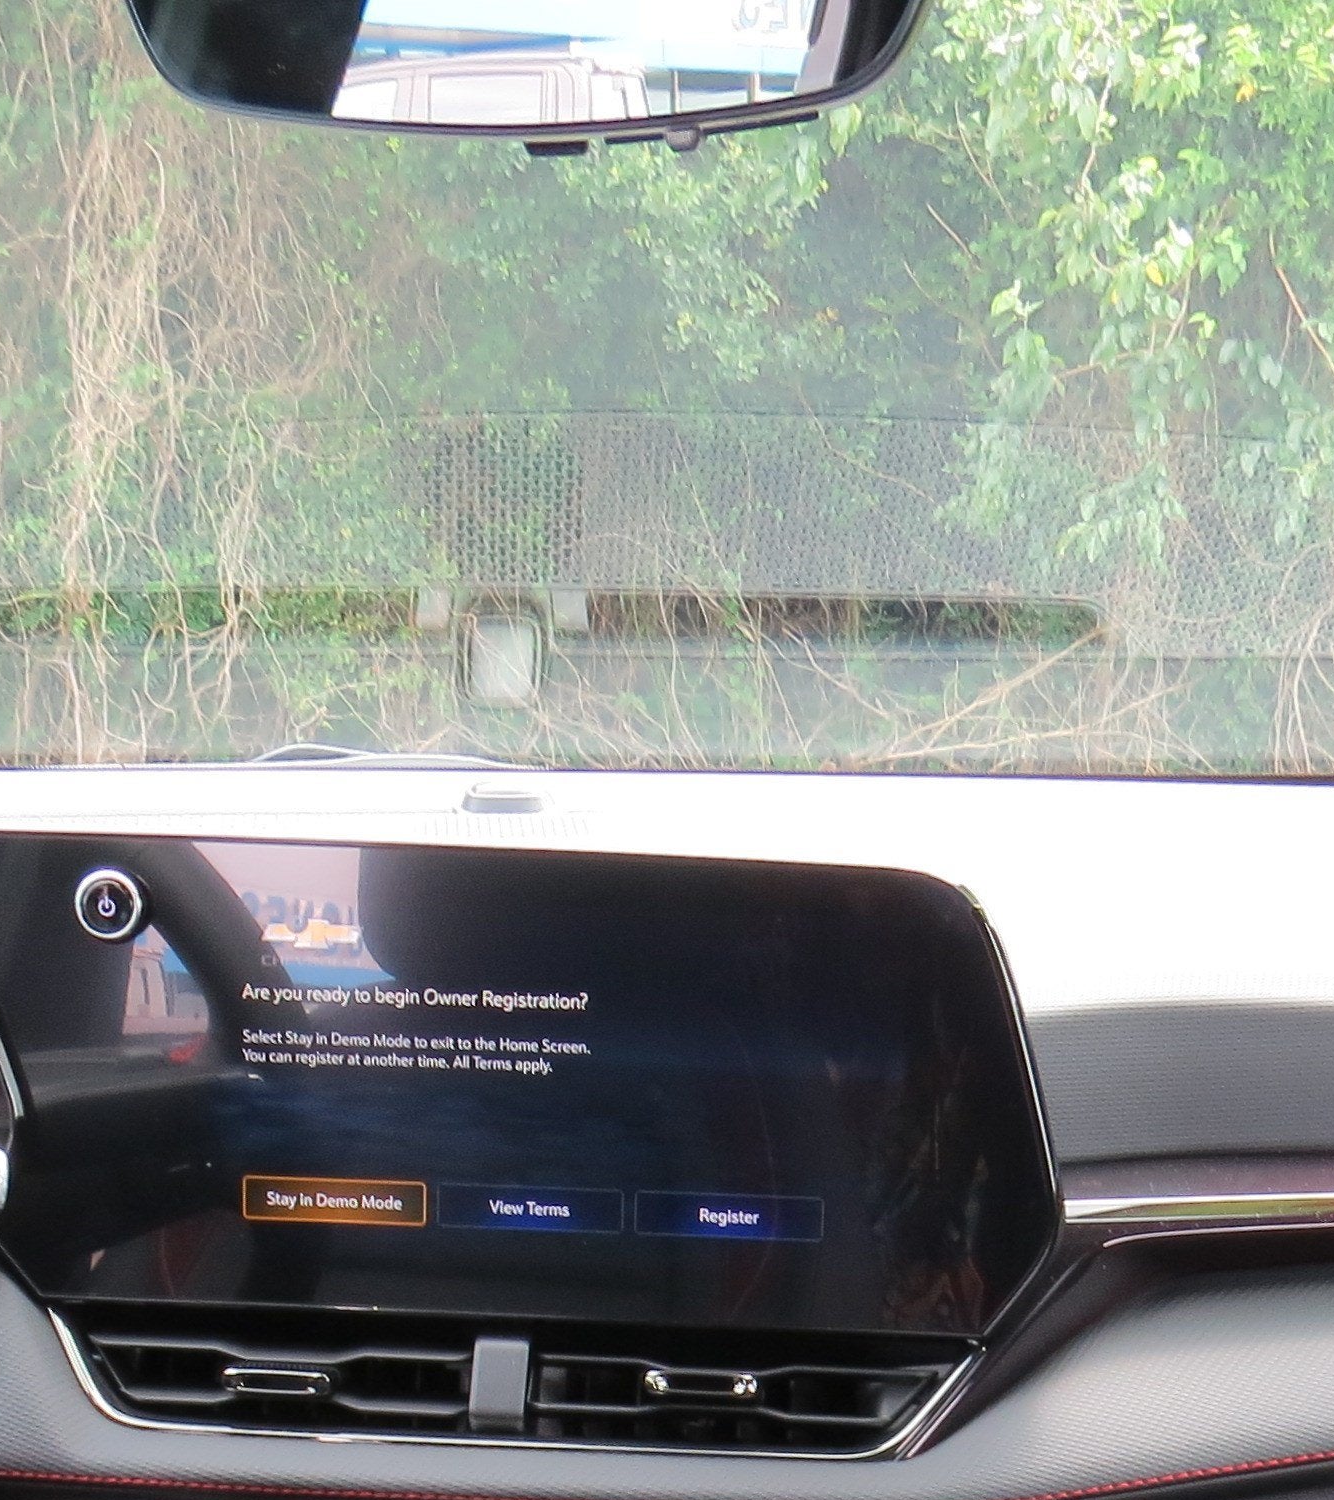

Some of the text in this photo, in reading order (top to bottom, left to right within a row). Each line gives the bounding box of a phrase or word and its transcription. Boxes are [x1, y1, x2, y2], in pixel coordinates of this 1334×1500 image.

[242, 983, 589, 1013] Are you ready to begin Owner Registration?
[242, 1029, 592, 1055] Select Stay in Demo Mode to exit to the Home Screen.
[242, 1049, 553, 1076] You can register at another time. All Terms apply.
[266, 1190, 403, 1212] Stay in Demo Mode
[488, 1199, 571, 1218] View Terms
[698, 1207, 760, 1228] Register
